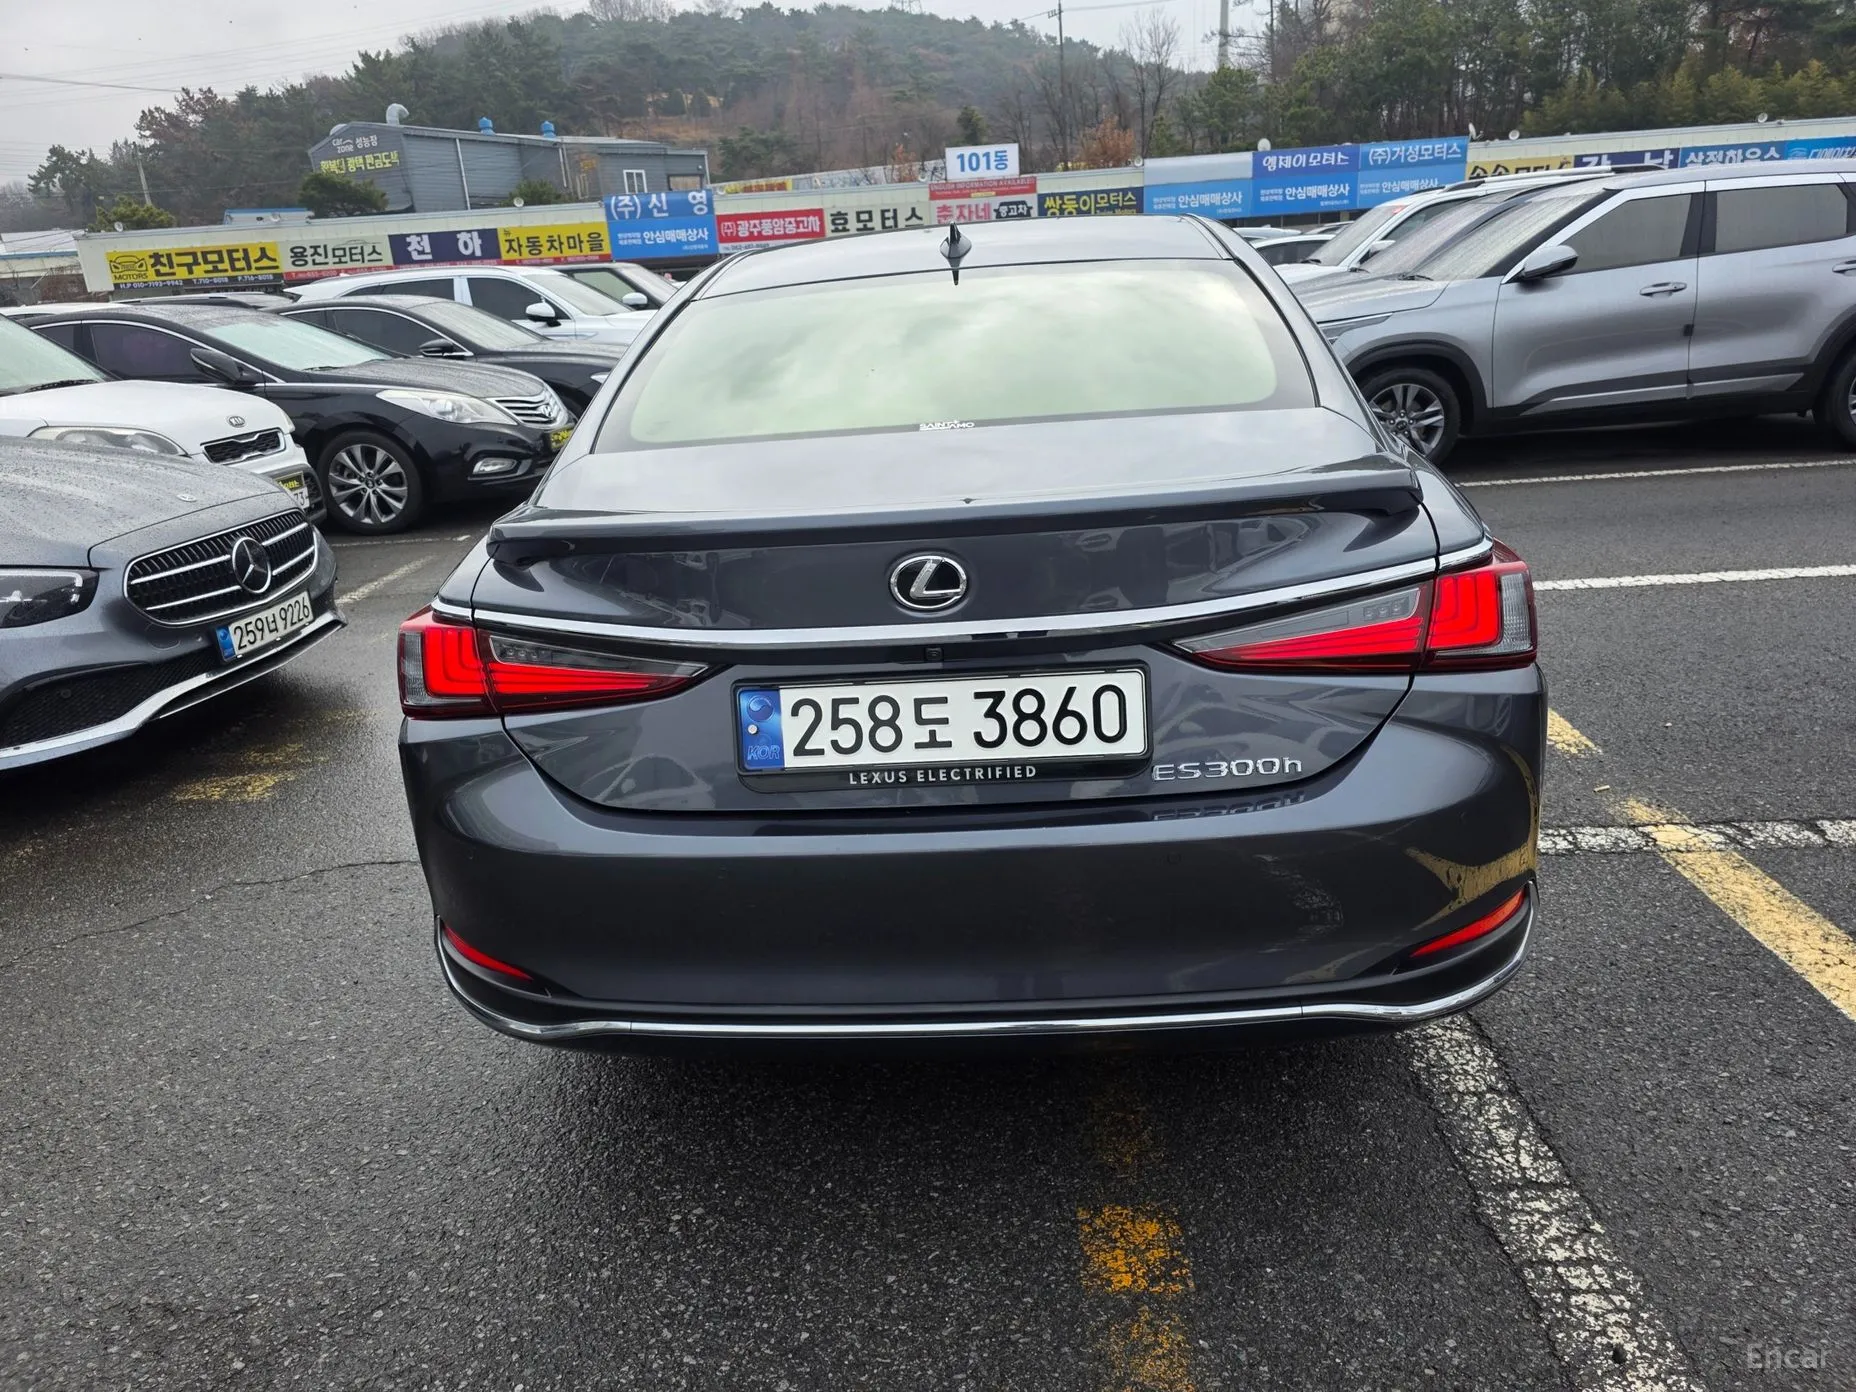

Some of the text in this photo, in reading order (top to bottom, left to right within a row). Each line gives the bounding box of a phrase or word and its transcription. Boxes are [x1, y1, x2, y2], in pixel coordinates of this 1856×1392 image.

[956, 150, 1008, 172] 101동
[957, 179, 998, 190] INFORMATION
[1285, 183, 1350, 200] 안심매매상사
[1382, 178, 1438, 193] 안심매매상사
[1178, 191, 1243, 208] 안심매매상사
[504, 231, 604, 256] 자동차마을
[643, 227, 709, 244] 안심매매상사
[148, 247, 279, 278] 친구모터스
[114, 273, 148, 281] MOTORS
[233, 597, 310, 651] 259너 9226
[790, 684, 1127, 757] 258도 3860
[747, 744, 781, 761] KOR
[849, 765, 1037, 785] LEXUS ELECTRIFIED
